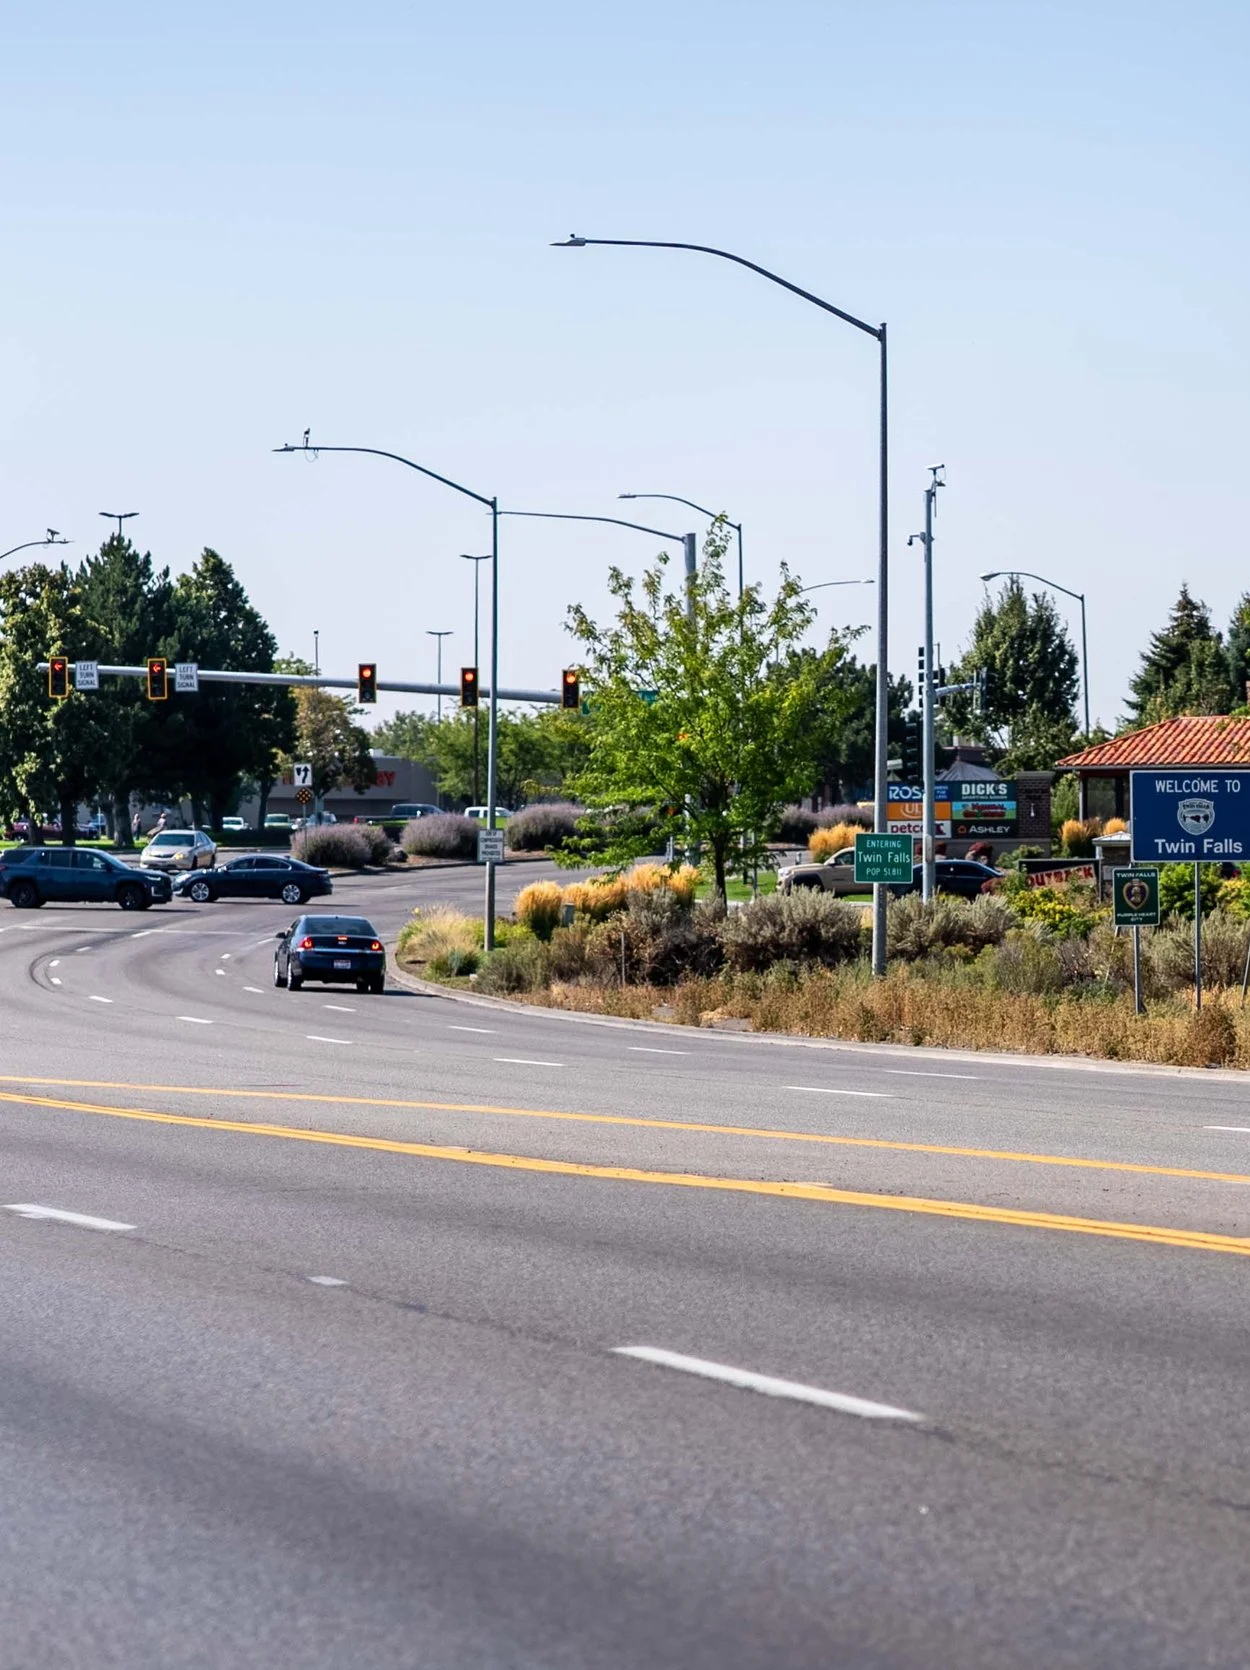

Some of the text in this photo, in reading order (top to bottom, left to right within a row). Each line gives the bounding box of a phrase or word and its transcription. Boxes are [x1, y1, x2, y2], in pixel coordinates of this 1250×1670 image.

[181, 665, 193, 673] LEFT
[962, 783, 1008, 795] DICK'S
[1155, 779, 1241, 793] WELCOME TO
[889, 786, 924, 799] ROS
[969, 825, 1010, 833] ASHLEY
[866, 839, 902, 848] ENTERING
[1154, 838, 1243, 853] Twin Falls
[858, 851, 911, 863] Twin Falls
[866, 867, 881, 876] POP
